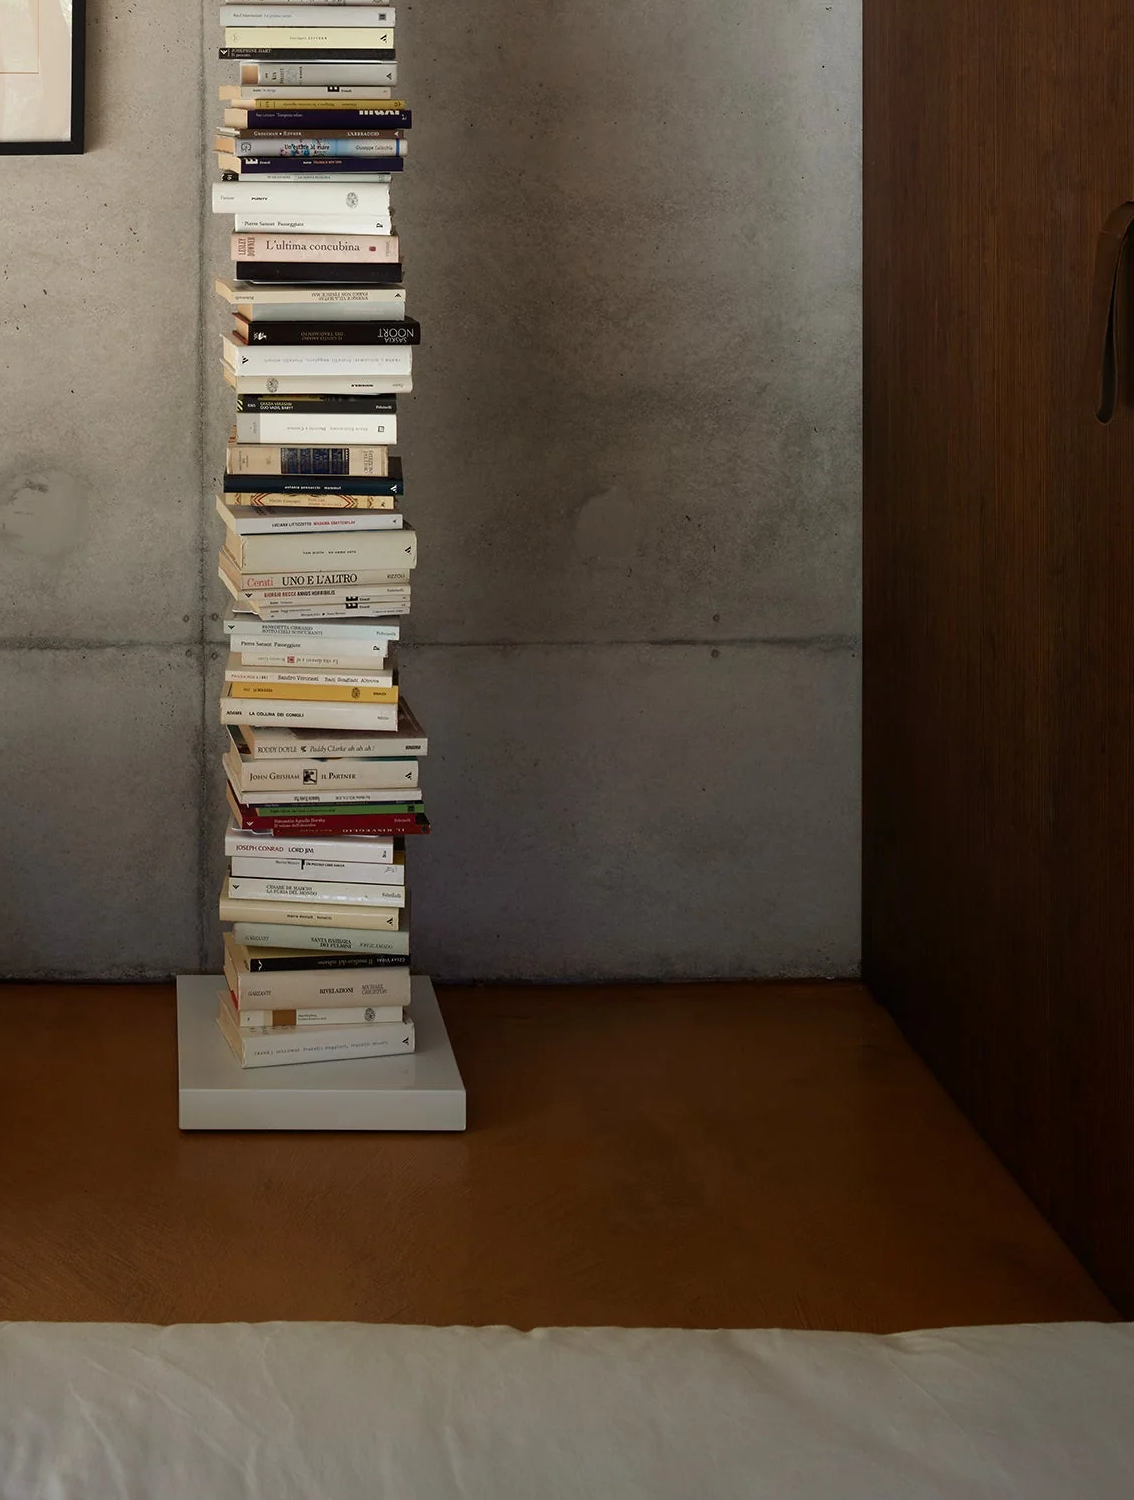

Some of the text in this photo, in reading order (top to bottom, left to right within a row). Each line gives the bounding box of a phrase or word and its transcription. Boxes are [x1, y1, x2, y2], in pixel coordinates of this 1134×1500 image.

[266, 240, 360, 252] L'ultima concubina
[377, 328, 414, 338] NOORT
[246, 577, 274, 587] Cerati
[282, 573, 358, 587] UNO E L'ALTRO
[249, 772, 300, 781] JOHN GRISHAM
[328, 772, 356, 780] PARTNER
